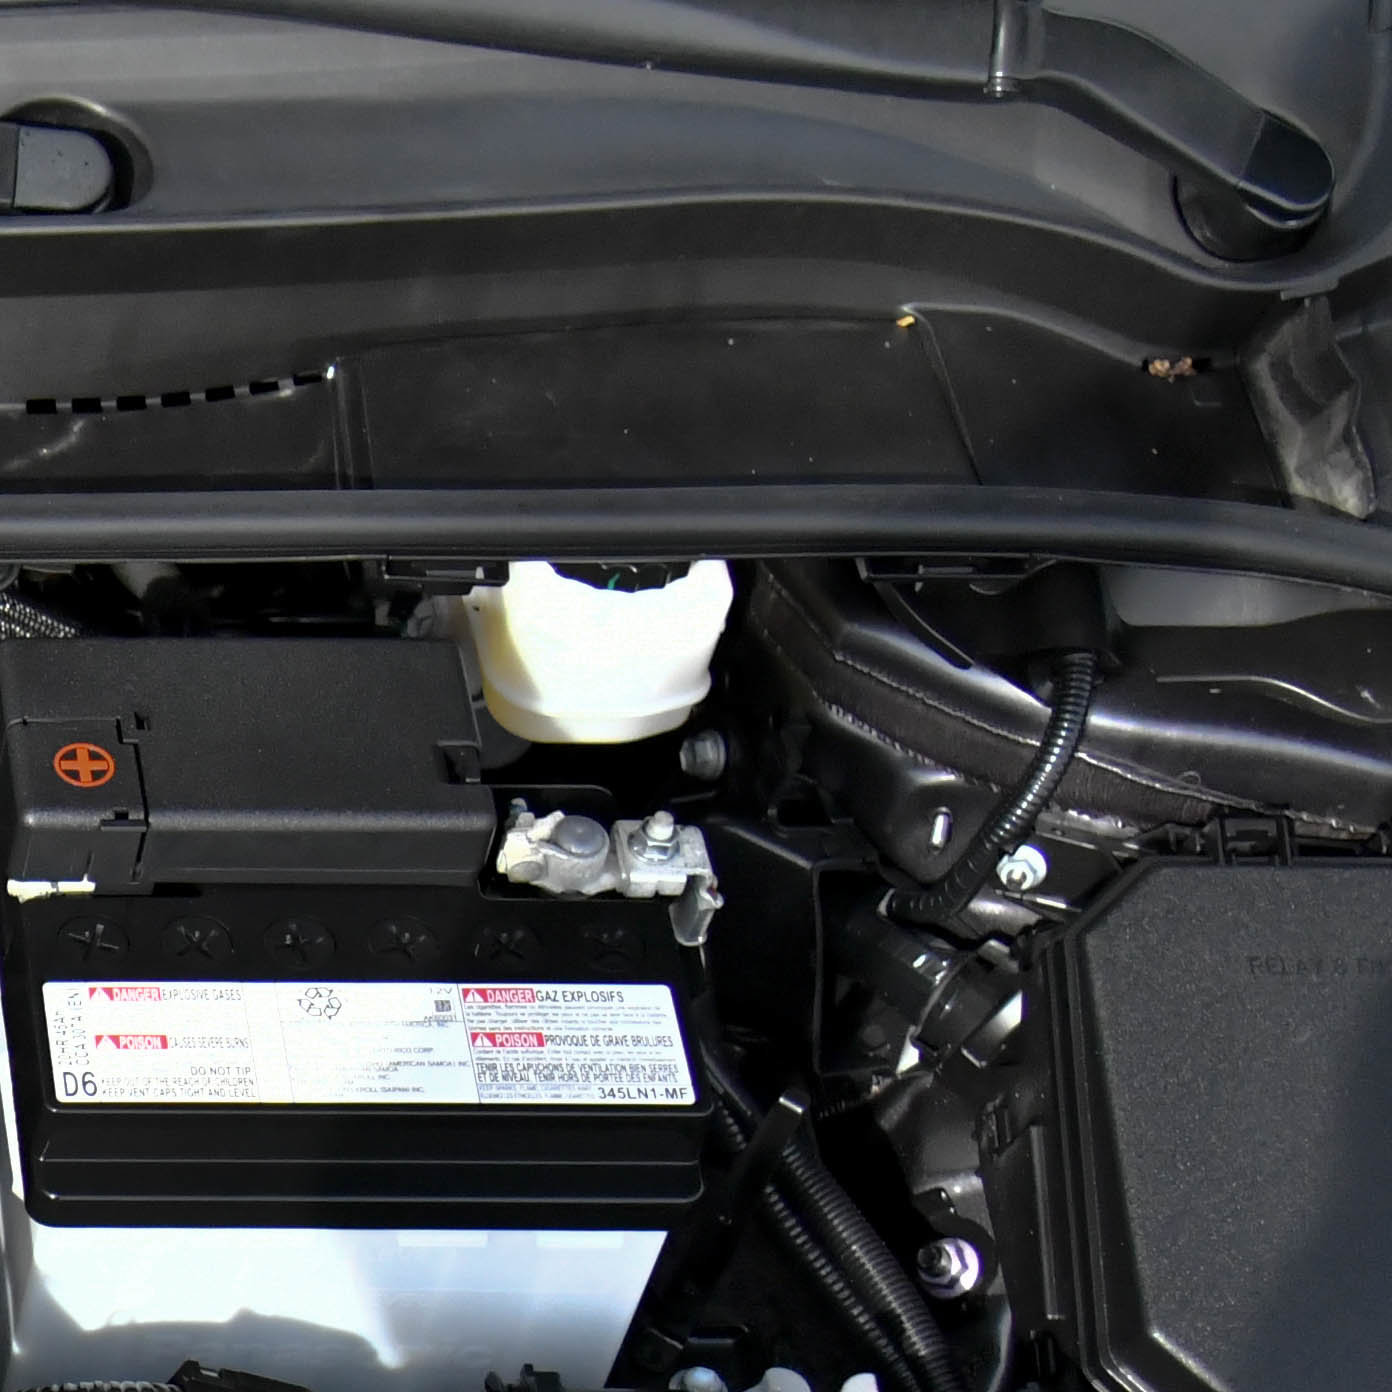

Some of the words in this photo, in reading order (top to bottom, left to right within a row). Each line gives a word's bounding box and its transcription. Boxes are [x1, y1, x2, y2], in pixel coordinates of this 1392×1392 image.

[112, 987, 160, 1001] DANGER
[162, 988, 210, 1000] EXPLOSIVE
[486, 989, 534, 1003] DANGER
[535, 990, 558, 1003] GAZ
[562, 991, 624, 1003] EXPLOSIFS
[119, 1036, 162, 1049] POISON
[495, 1034, 538, 1047] POISON
[544, 1034, 588, 1047] PROVOQUE
[589, 1035, 601, 1047] DE
[603, 1035, 630, 1047] GRAVE
[190, 1066, 207, 1075] DO
[209, 1066, 231, 1075] NOT
[236, 1066, 251, 1075] TIP
[516, 1063, 564, 1073] CAPUCHONS
[578, 1063, 627, 1073] VENTILATION
[63, 1071, 98, 1097] D6
[598, 1087, 689, 1100] 345LN1-MF
